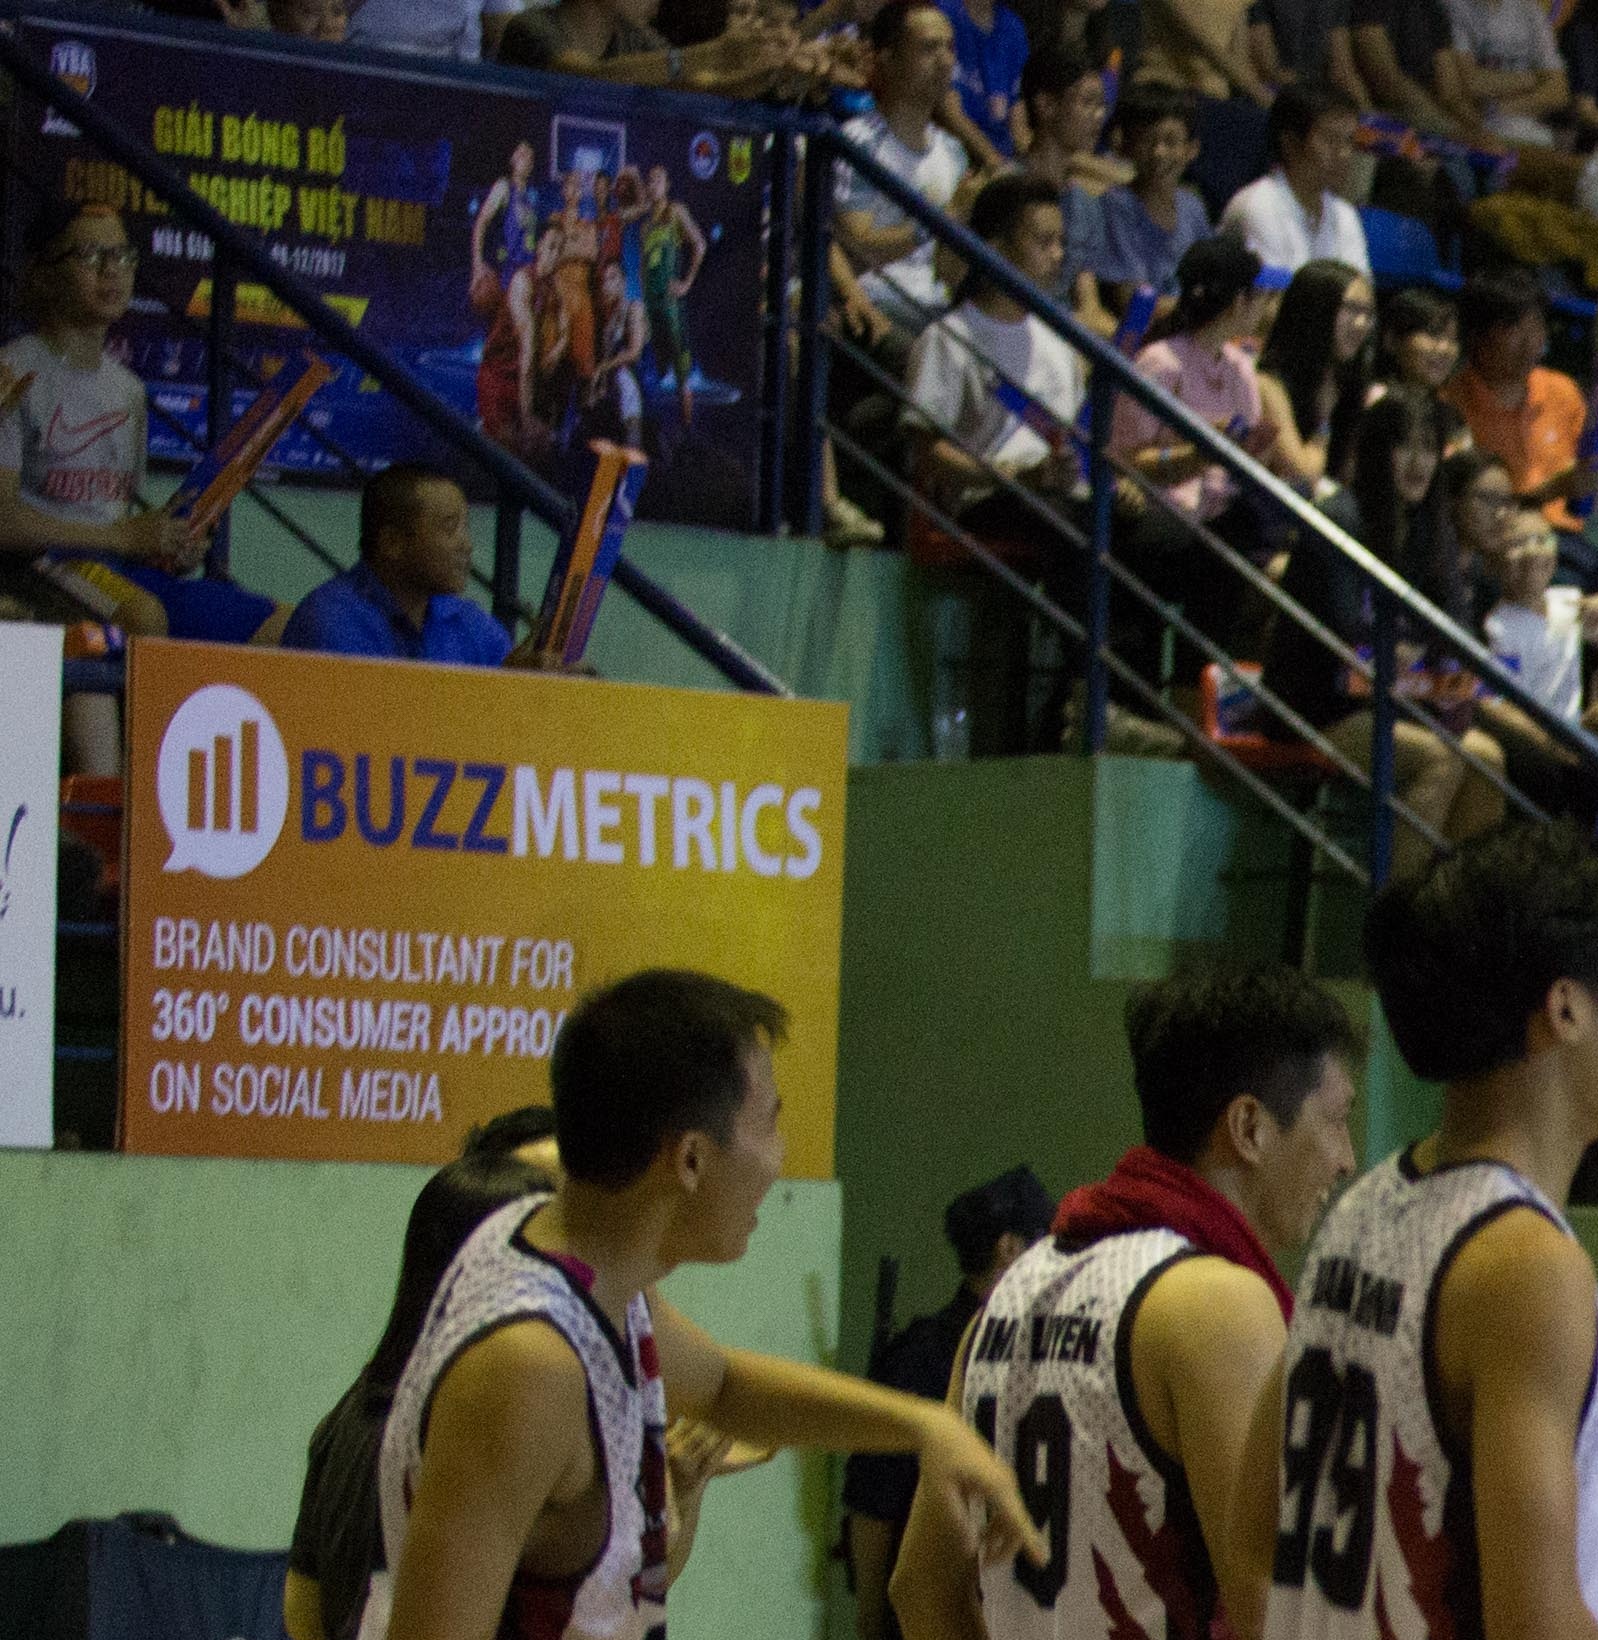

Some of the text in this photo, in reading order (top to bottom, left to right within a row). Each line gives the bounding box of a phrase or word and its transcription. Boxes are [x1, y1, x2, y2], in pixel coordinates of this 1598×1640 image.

[300, 748, 824, 881] BUZZMETRICS
[154, 917, 576, 990] BRAND CONSULTANT FOR
[151, 987, 229, 1044] 360°
[238, 995, 431, 1055] CONSUMER
[149, 1063, 444, 1124] ON SOCIAL MEDIA
[975, 1392, 1072, 1611] 9
